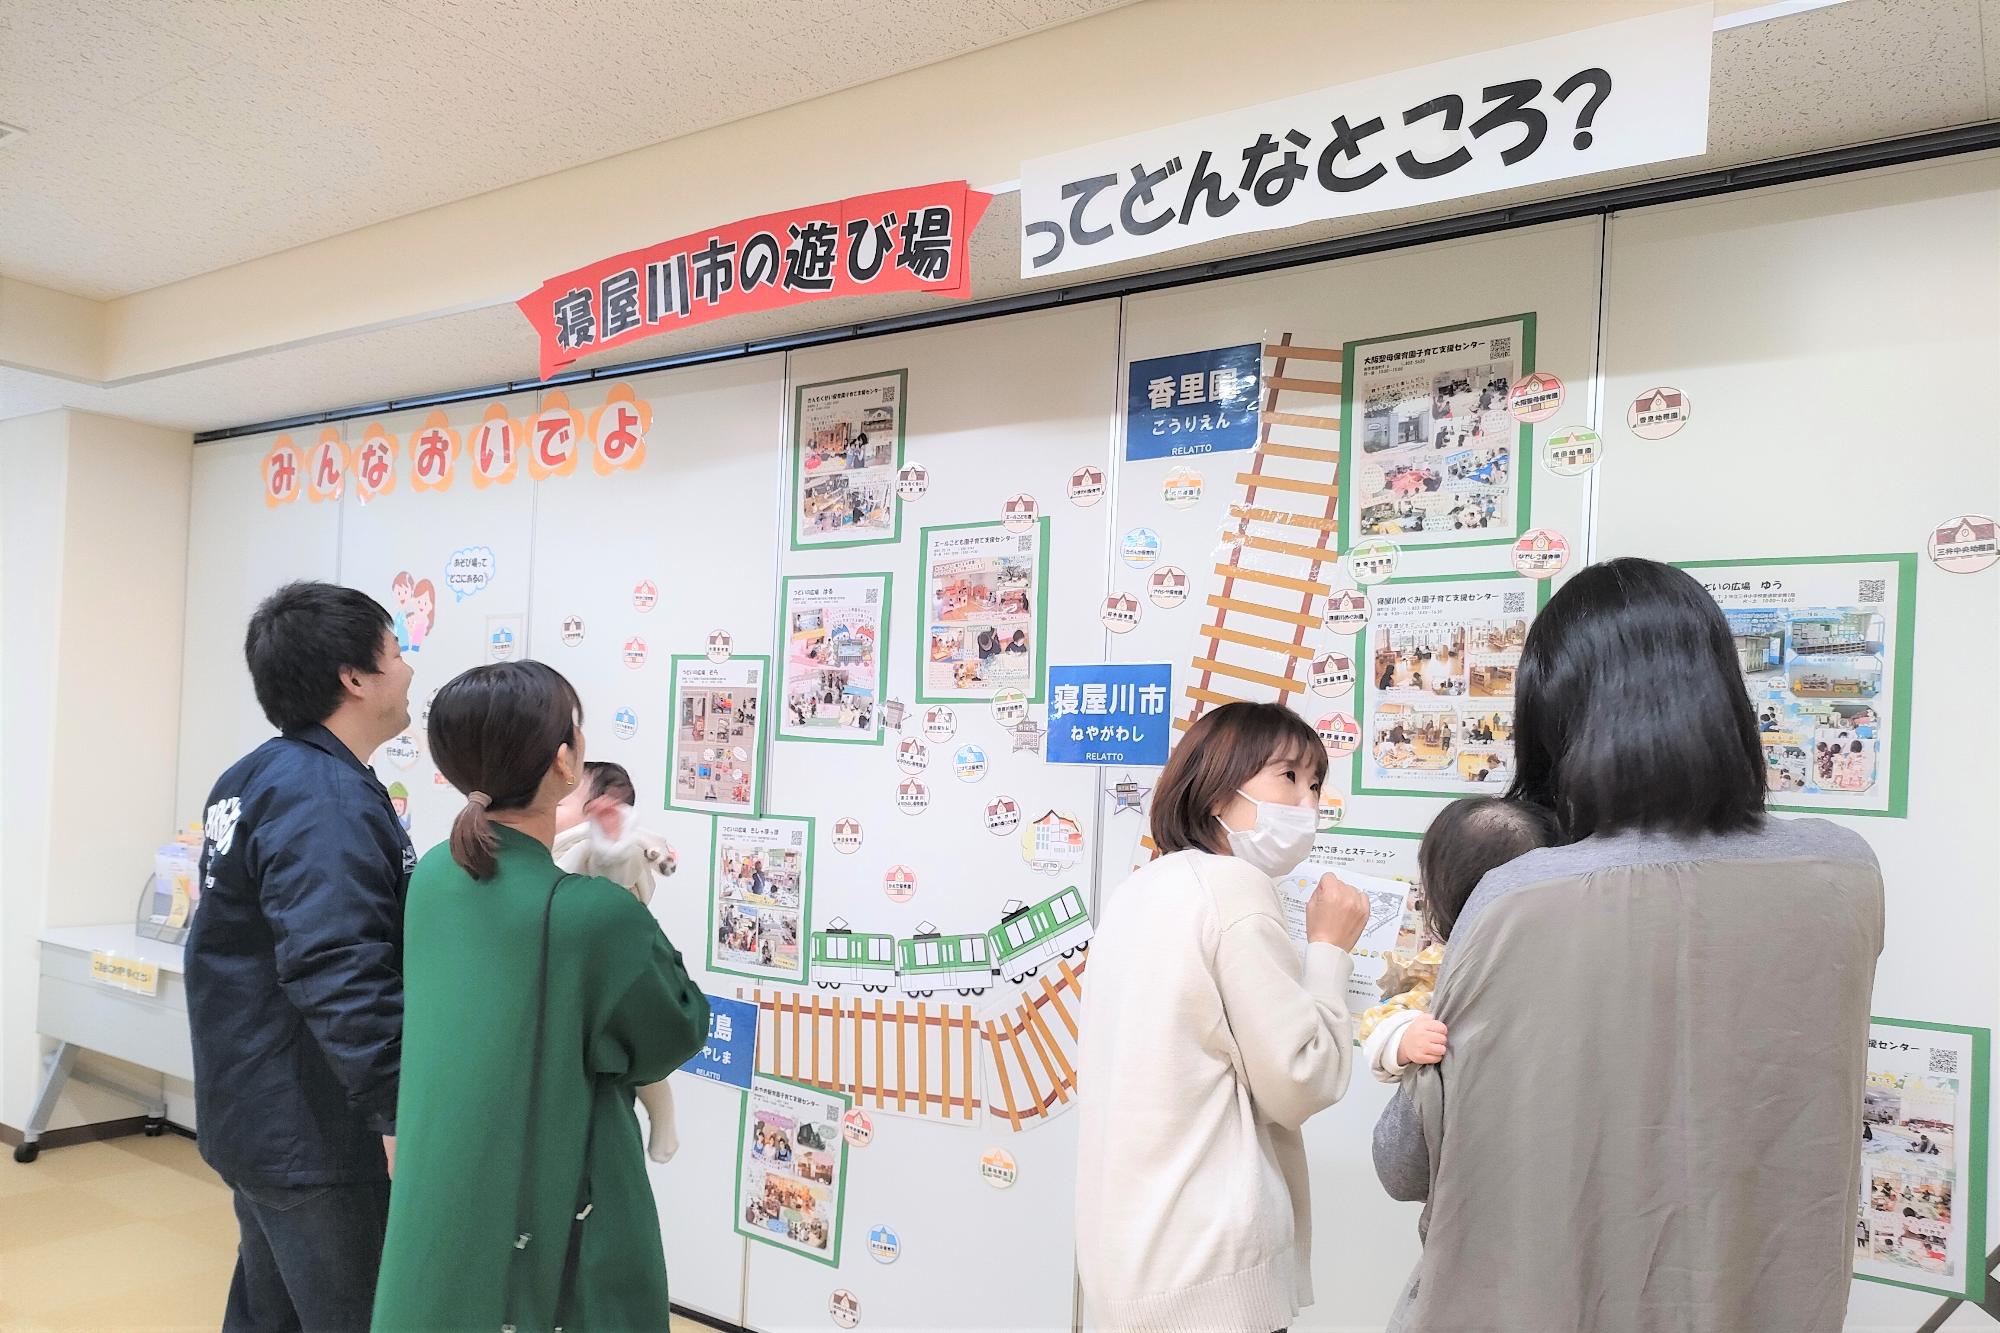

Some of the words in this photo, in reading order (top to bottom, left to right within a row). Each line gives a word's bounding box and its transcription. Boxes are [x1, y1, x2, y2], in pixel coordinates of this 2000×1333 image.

[1025, 67, 1612, 268] ってどんなところ？
[552, 206, 952, 352] 寝屋川市の遊び場
[1147, 368, 1238, 410] 香里園
[1152, 412, 1231, 436] こうりえん
[271, 408, 638, 490] みんなおいでよ
[1171, 443, 1213, 456] RELATTO
[454, 557, 488, 568] あそび場って
[1761, 580, 1782, 590] ゆう
[1053, 683, 1168, 716] 寝屋川市
[1070, 726, 1145, 742] ねやがわし
[1085, 752, 1124, 761] RELATTO
[708, 1013, 733, 1042] 島
[701, 1045, 732, 1065] やしま
[695, 1067, 721, 1081] RELATTO
